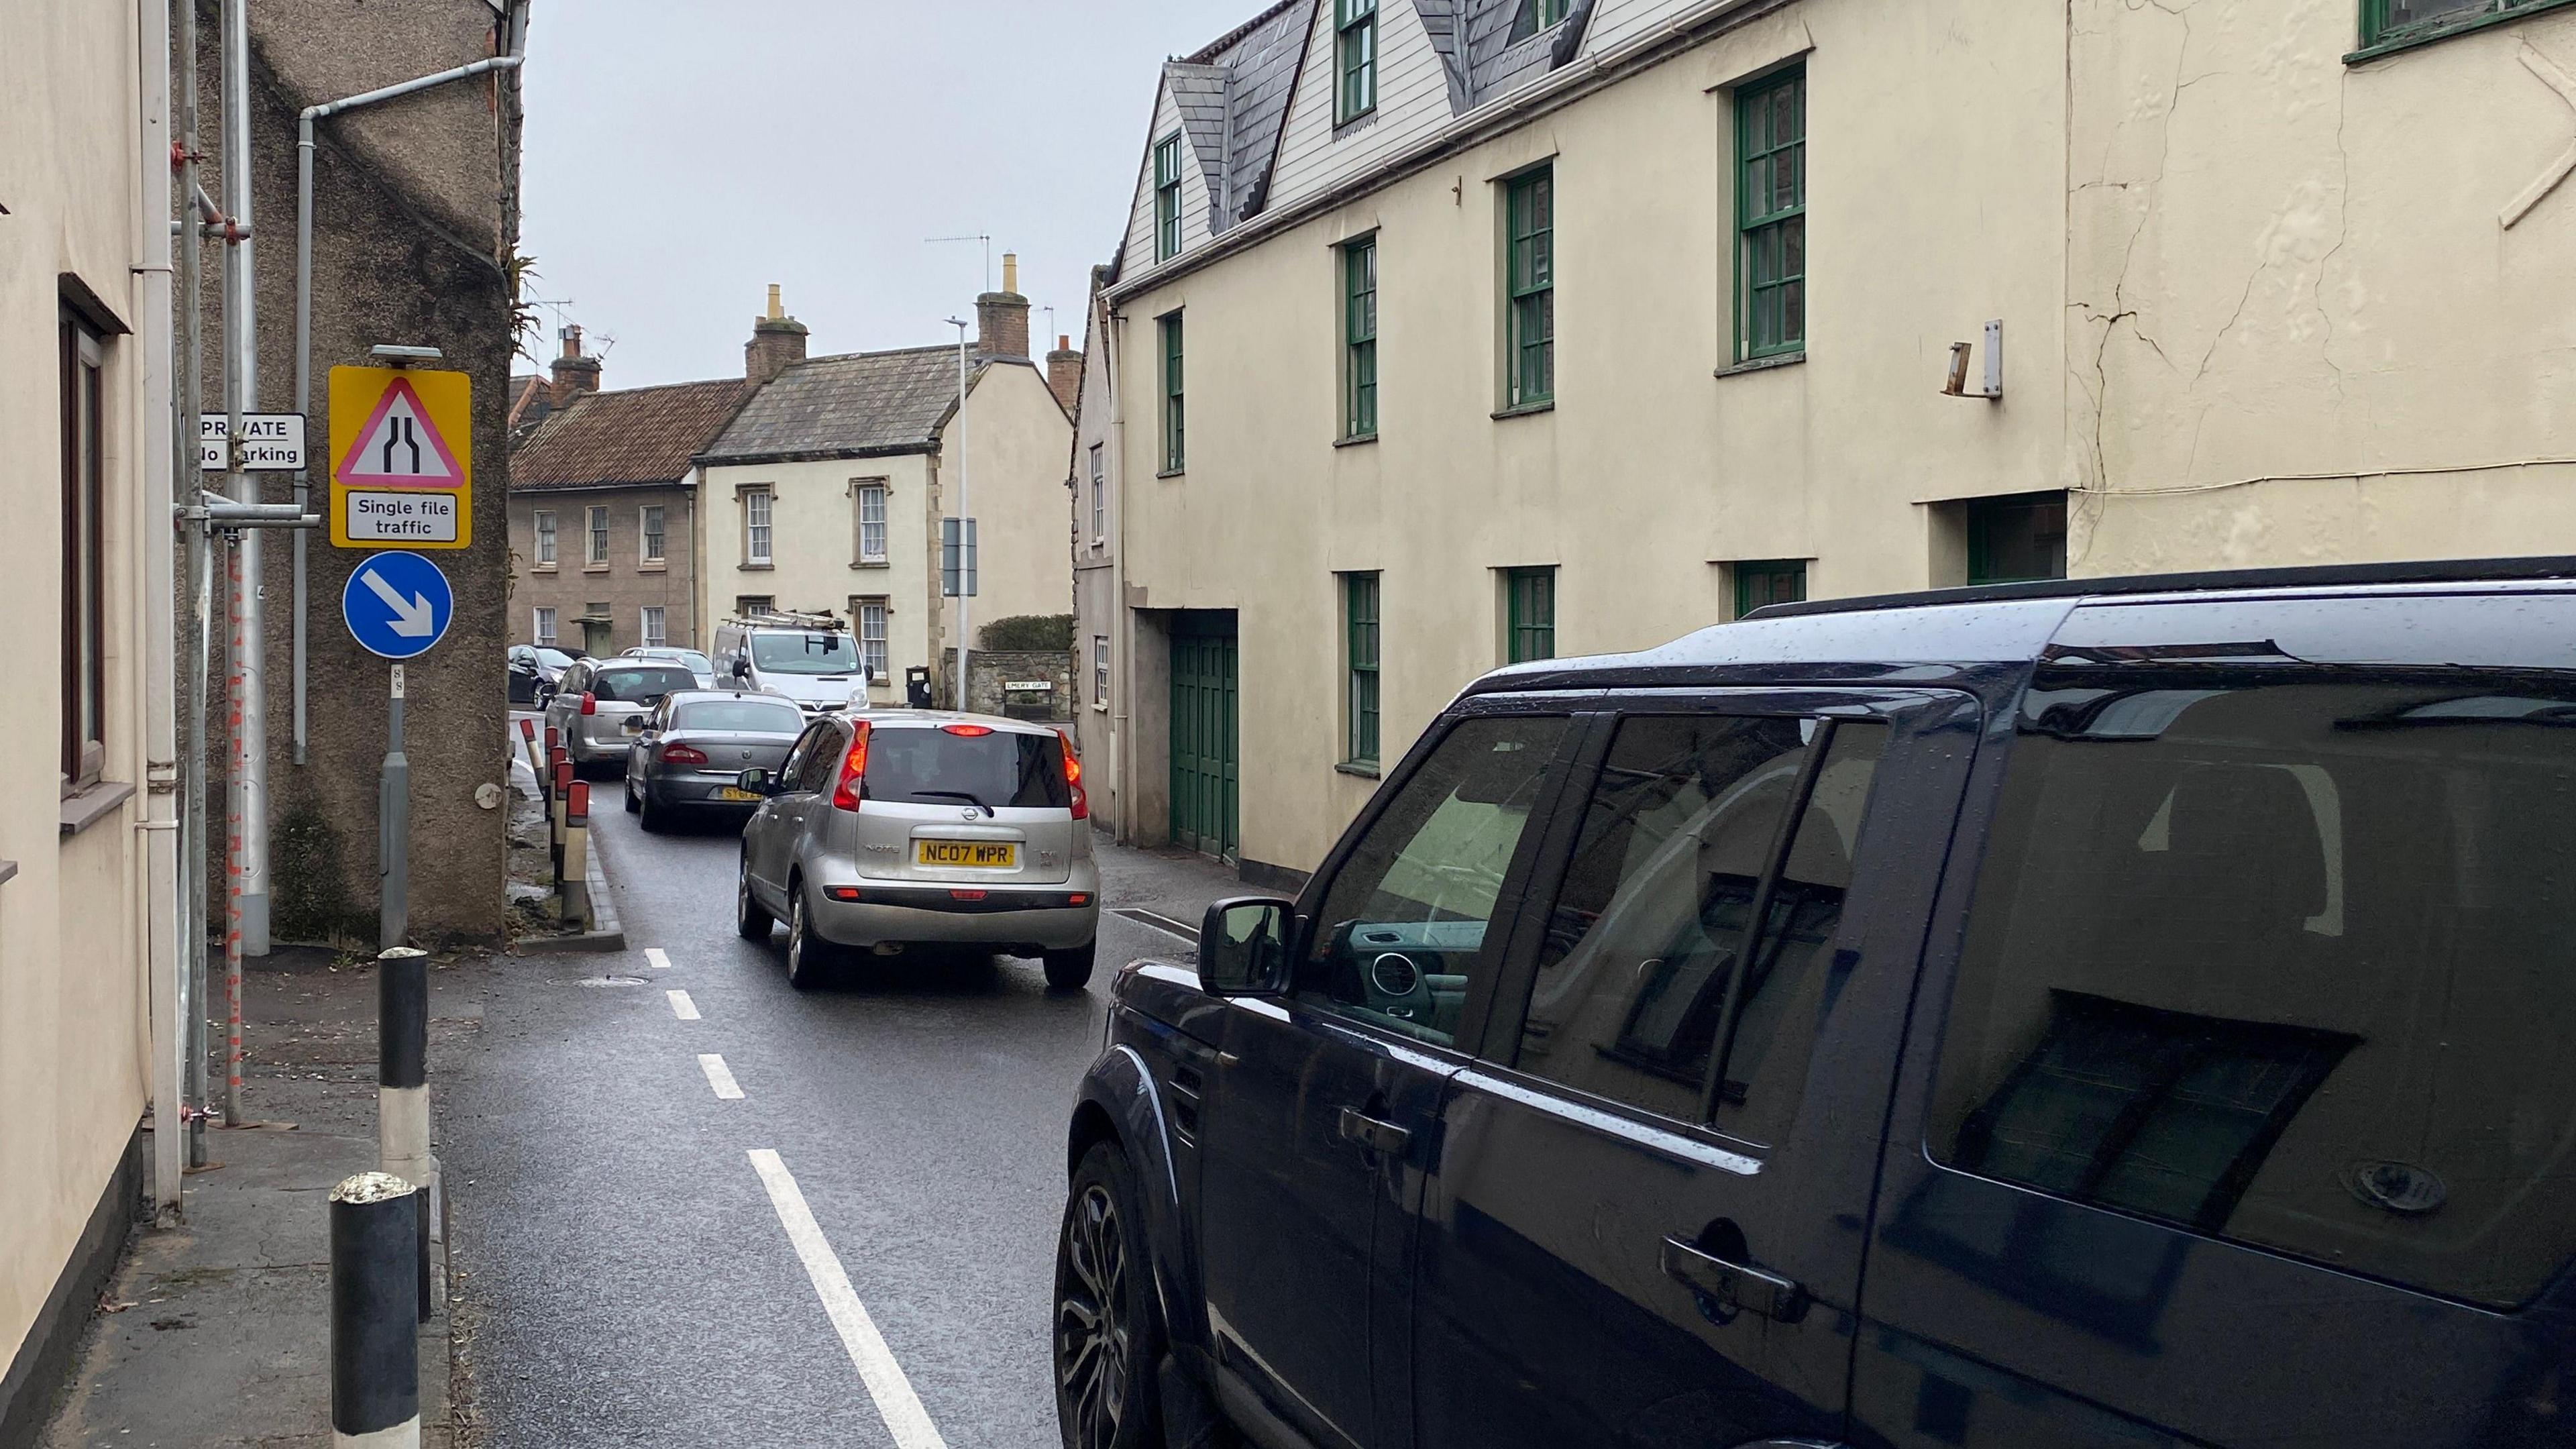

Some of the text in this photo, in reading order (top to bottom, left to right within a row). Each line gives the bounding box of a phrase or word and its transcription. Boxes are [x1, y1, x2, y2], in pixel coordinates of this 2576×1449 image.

[243, 447, 297, 464] arking
[358, 500, 449, 516] Single file
[376, 520, 431, 534] traffic
[926, 845, 1007, 862] NC07 WPR
